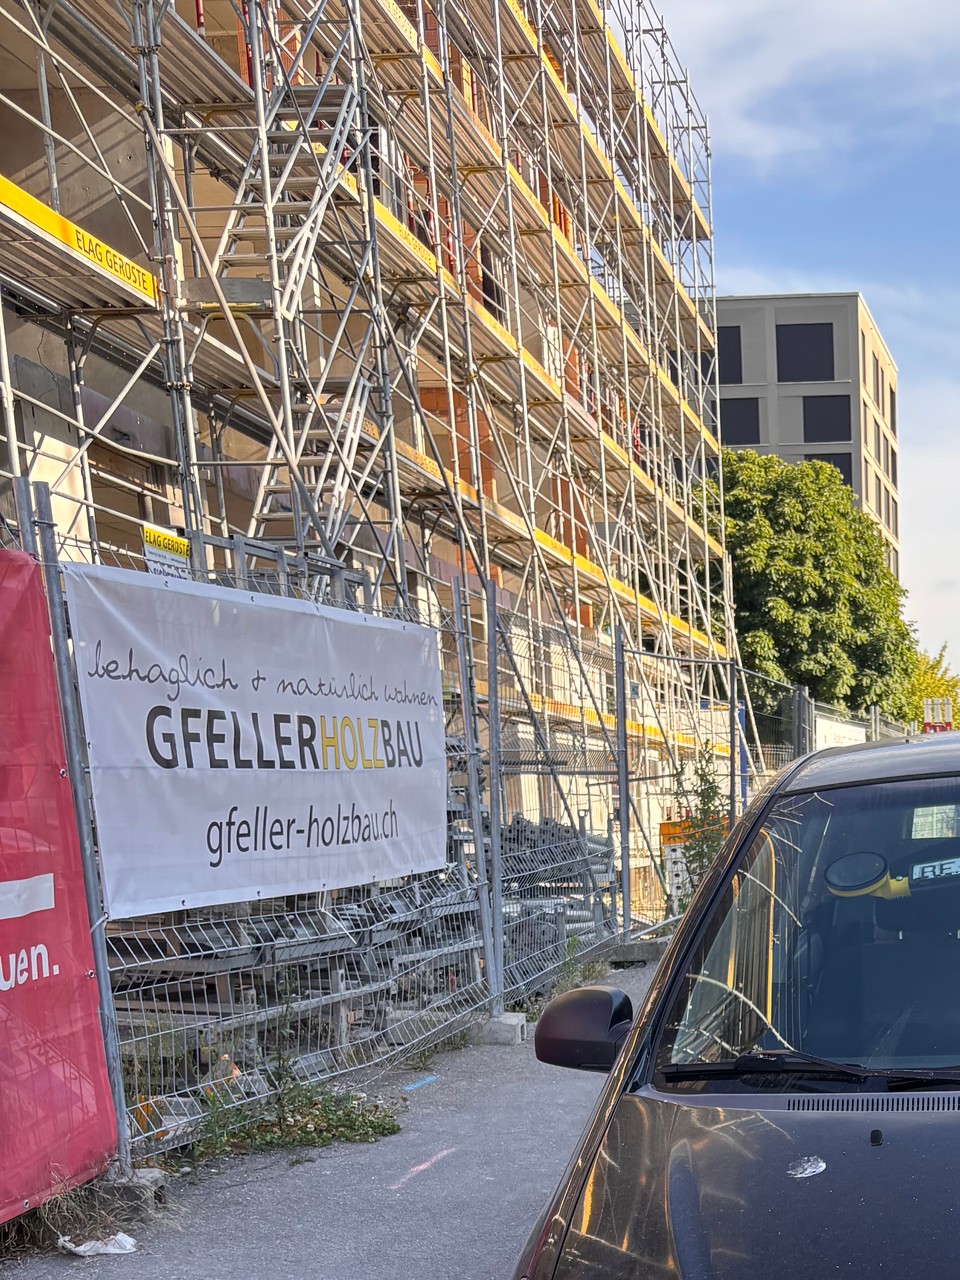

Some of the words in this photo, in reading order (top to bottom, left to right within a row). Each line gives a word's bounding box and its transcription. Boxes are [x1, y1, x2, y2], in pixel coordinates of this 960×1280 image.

[75, 229, 103, 262] ELAG
[145, 531, 161, 547] ELAG
[88, 639, 238, 702] behaglich
[276, 673, 379, 702] natürlich
[384, 680, 438, 707] wohnen
[145, 704, 424, 770] GFELLERHOLZBAU
[206, 799, 399, 868] gfeller-holzbau.ch
